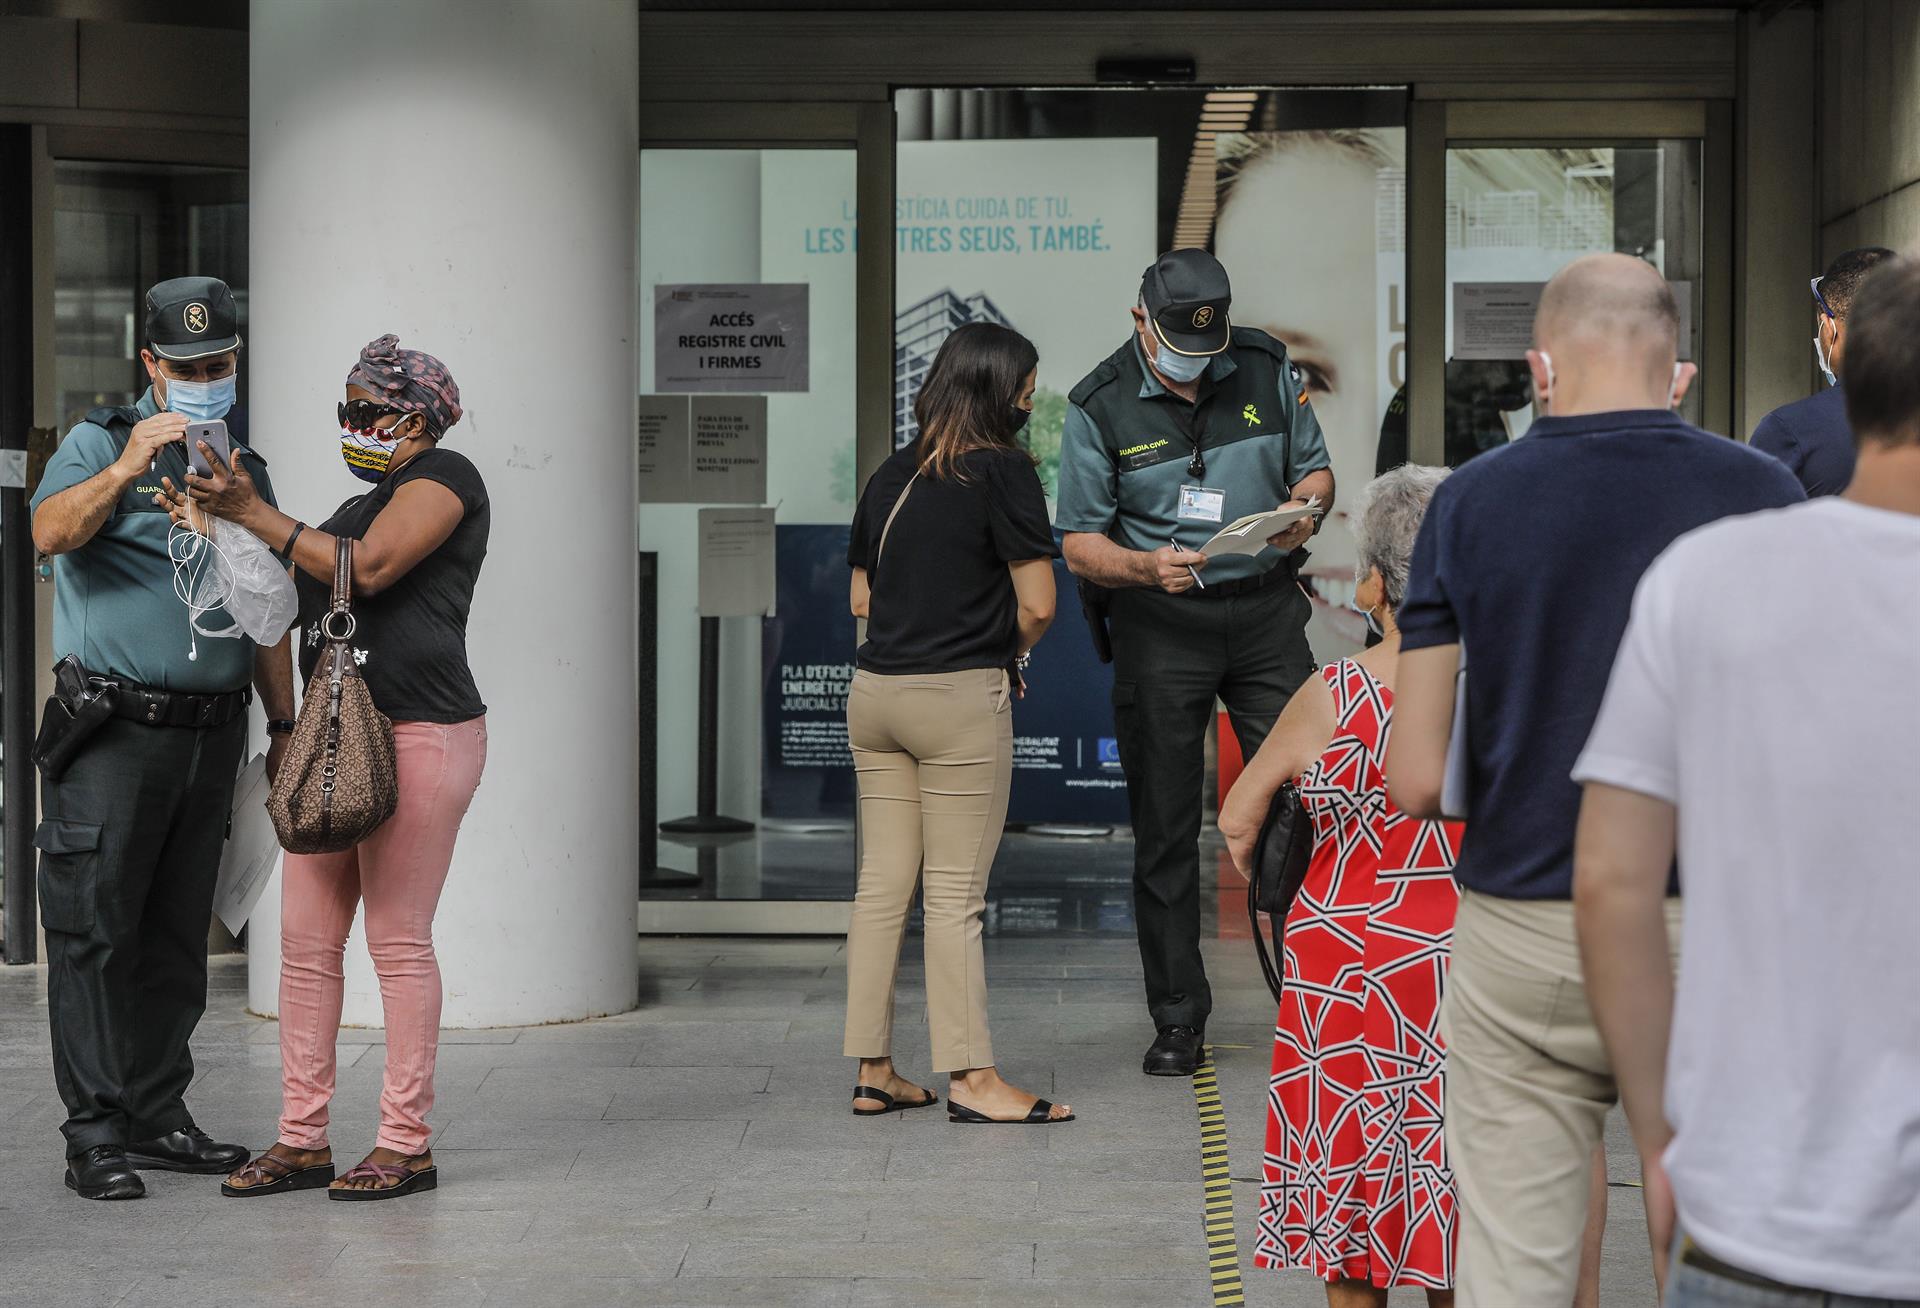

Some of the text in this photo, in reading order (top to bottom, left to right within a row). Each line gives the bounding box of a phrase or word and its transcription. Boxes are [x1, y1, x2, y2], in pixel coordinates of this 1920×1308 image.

[842, 195, 1073, 221] L STÍCIA CUIDA DE TU.
[805, 228, 845, 253] LES
[959, 226, 1021, 254] SEUS,
[1029, 218, 1111, 251] TAMBÉ.
[709, 311, 754, 327] ACCÉS
[678, 335, 786, 348] REGISTRE CIVIL
[700, 356, 761, 369] I FIRMES
[1150, 439, 1168, 448] CIVIL
[782, 665, 804, 679] PLA
